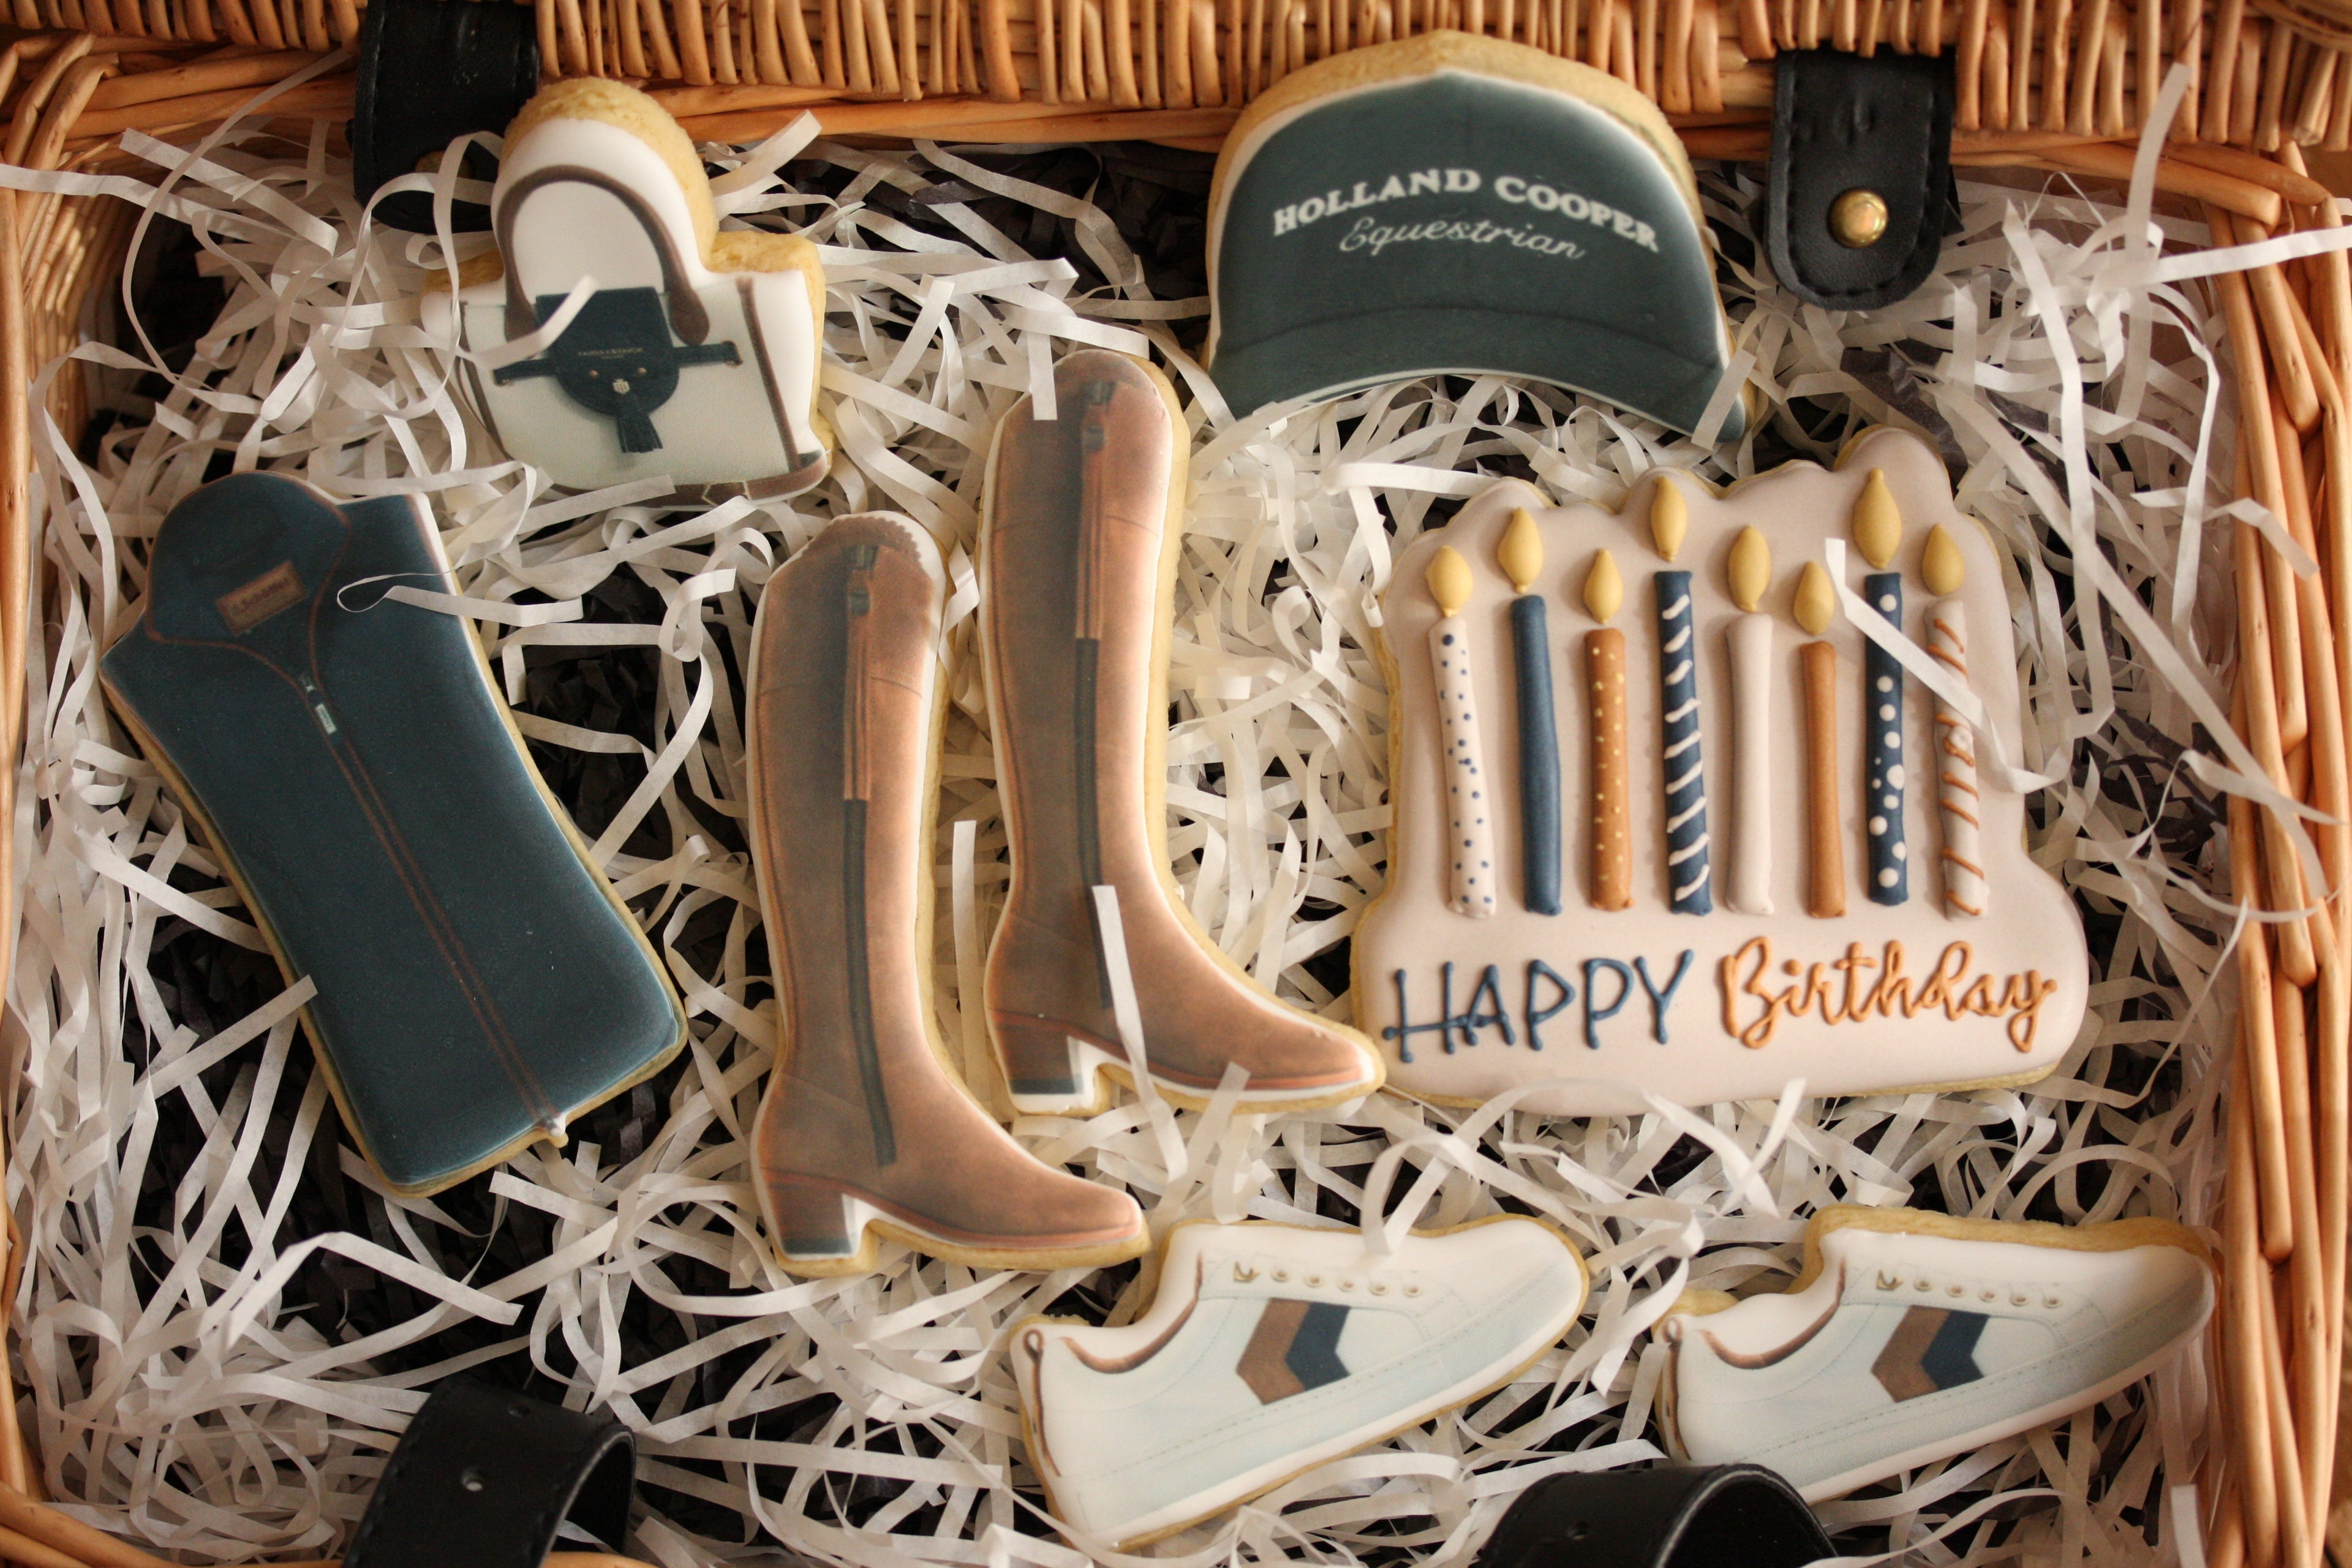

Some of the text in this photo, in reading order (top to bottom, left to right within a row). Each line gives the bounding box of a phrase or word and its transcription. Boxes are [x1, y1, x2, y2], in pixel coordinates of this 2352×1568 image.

[1273, 168, 1659, 252] HOLLAND COOPER
[1339, 216, 1586, 260] Equestrian
[1381, 935, 2058, 1063] HAPPY Birthday
